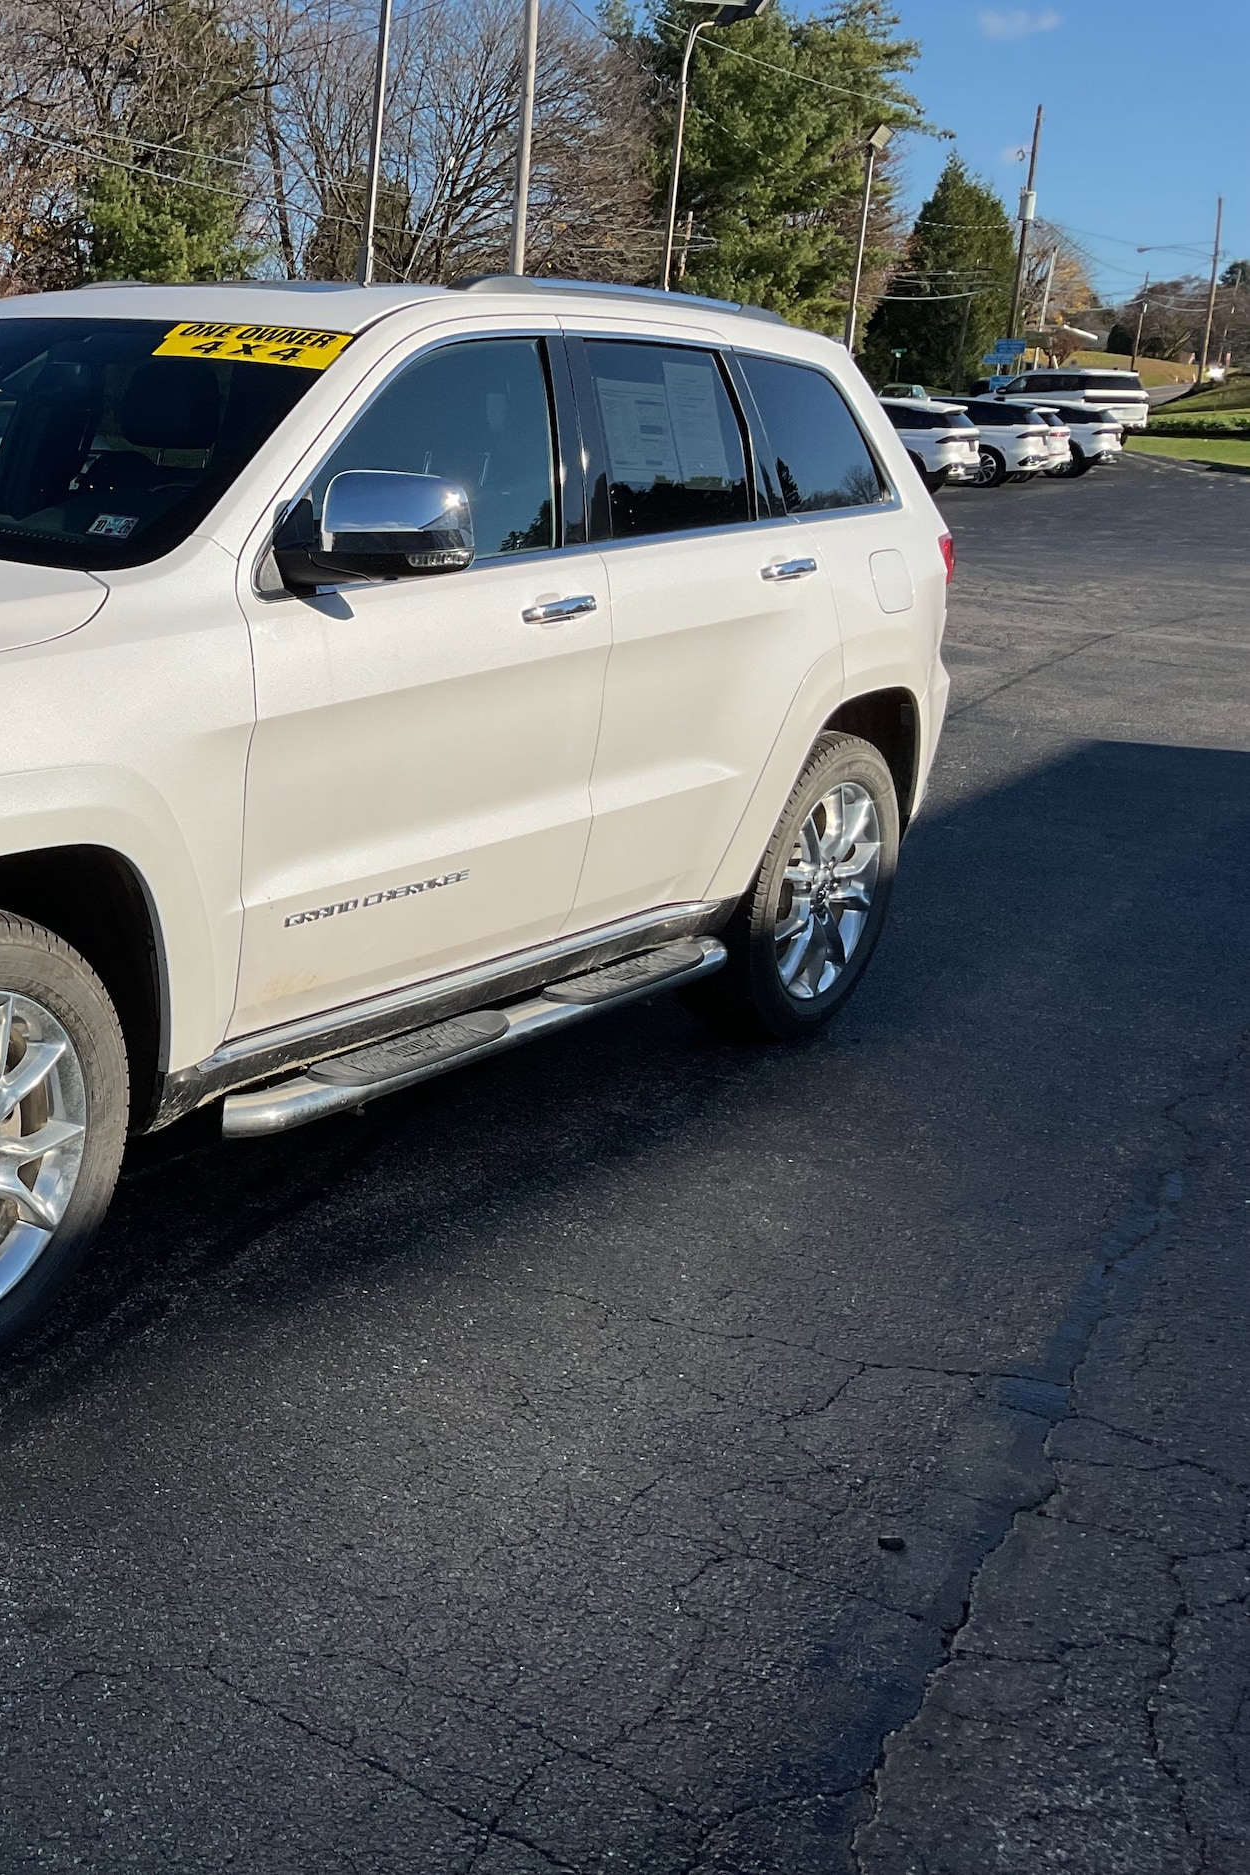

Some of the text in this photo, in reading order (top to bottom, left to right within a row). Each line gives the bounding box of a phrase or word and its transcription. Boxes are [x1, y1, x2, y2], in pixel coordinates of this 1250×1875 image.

[179, 324, 338, 349] ONE OWNER
[283, 868, 470, 928] GRAND CHEROKEE
